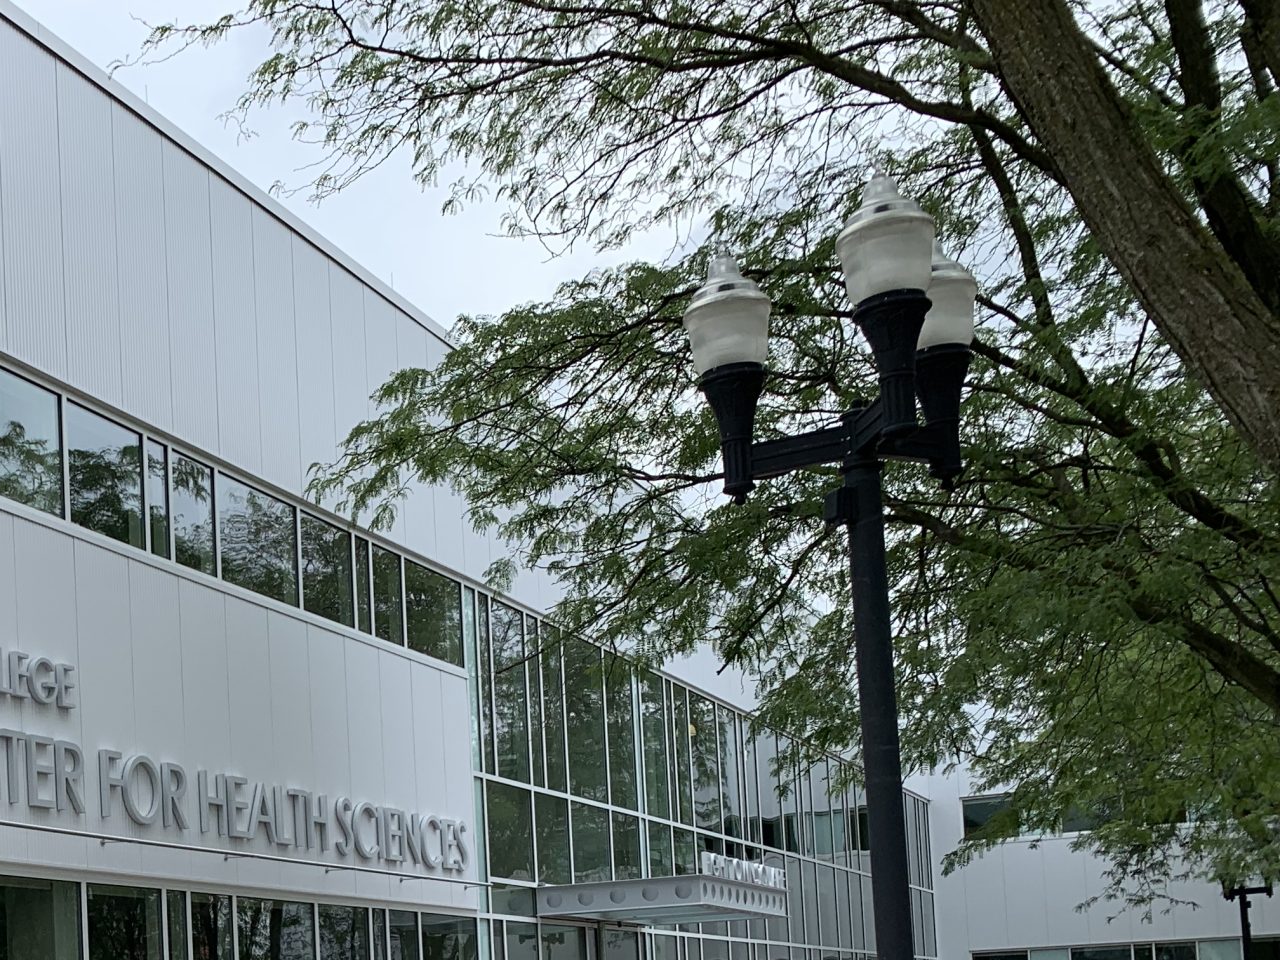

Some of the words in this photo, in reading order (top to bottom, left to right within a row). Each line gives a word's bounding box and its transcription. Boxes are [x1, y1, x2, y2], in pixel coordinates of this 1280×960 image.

[98, 748, 190, 830] FOR
[197, 768, 331, 852] HEALTH
[334, 796, 469, 873] SCIENCES
